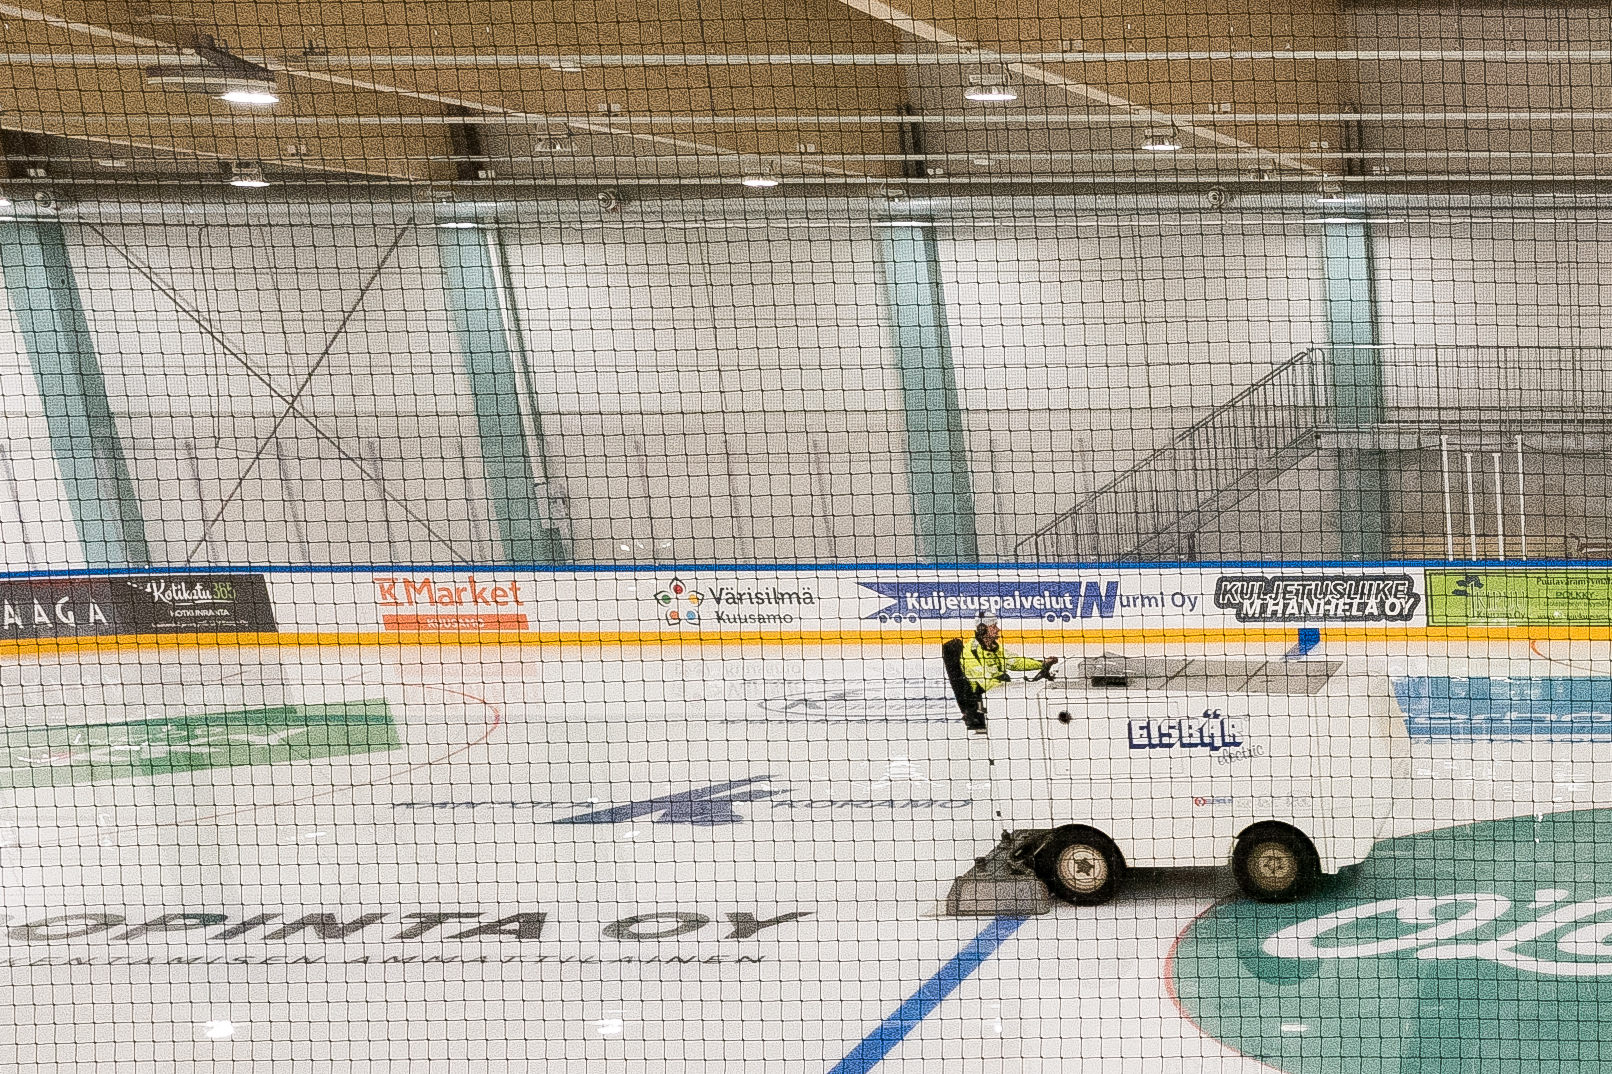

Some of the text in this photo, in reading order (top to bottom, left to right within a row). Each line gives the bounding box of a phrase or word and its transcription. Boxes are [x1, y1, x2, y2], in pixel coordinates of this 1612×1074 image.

[403, 576, 524, 606] Market
[709, 587, 815, 605] Värisilmä
[905, 590, 1073, 614] Kuljetuspalvelut
[1175, 591, 1198, 612] Oy
[1219, 581, 1409, 603] KULJETUSLIIKE
[714, 611, 793, 624] Kuusamo
[1384, 598, 1415, 616] OY
[0, 911, 817, 941] OPINTA OY
